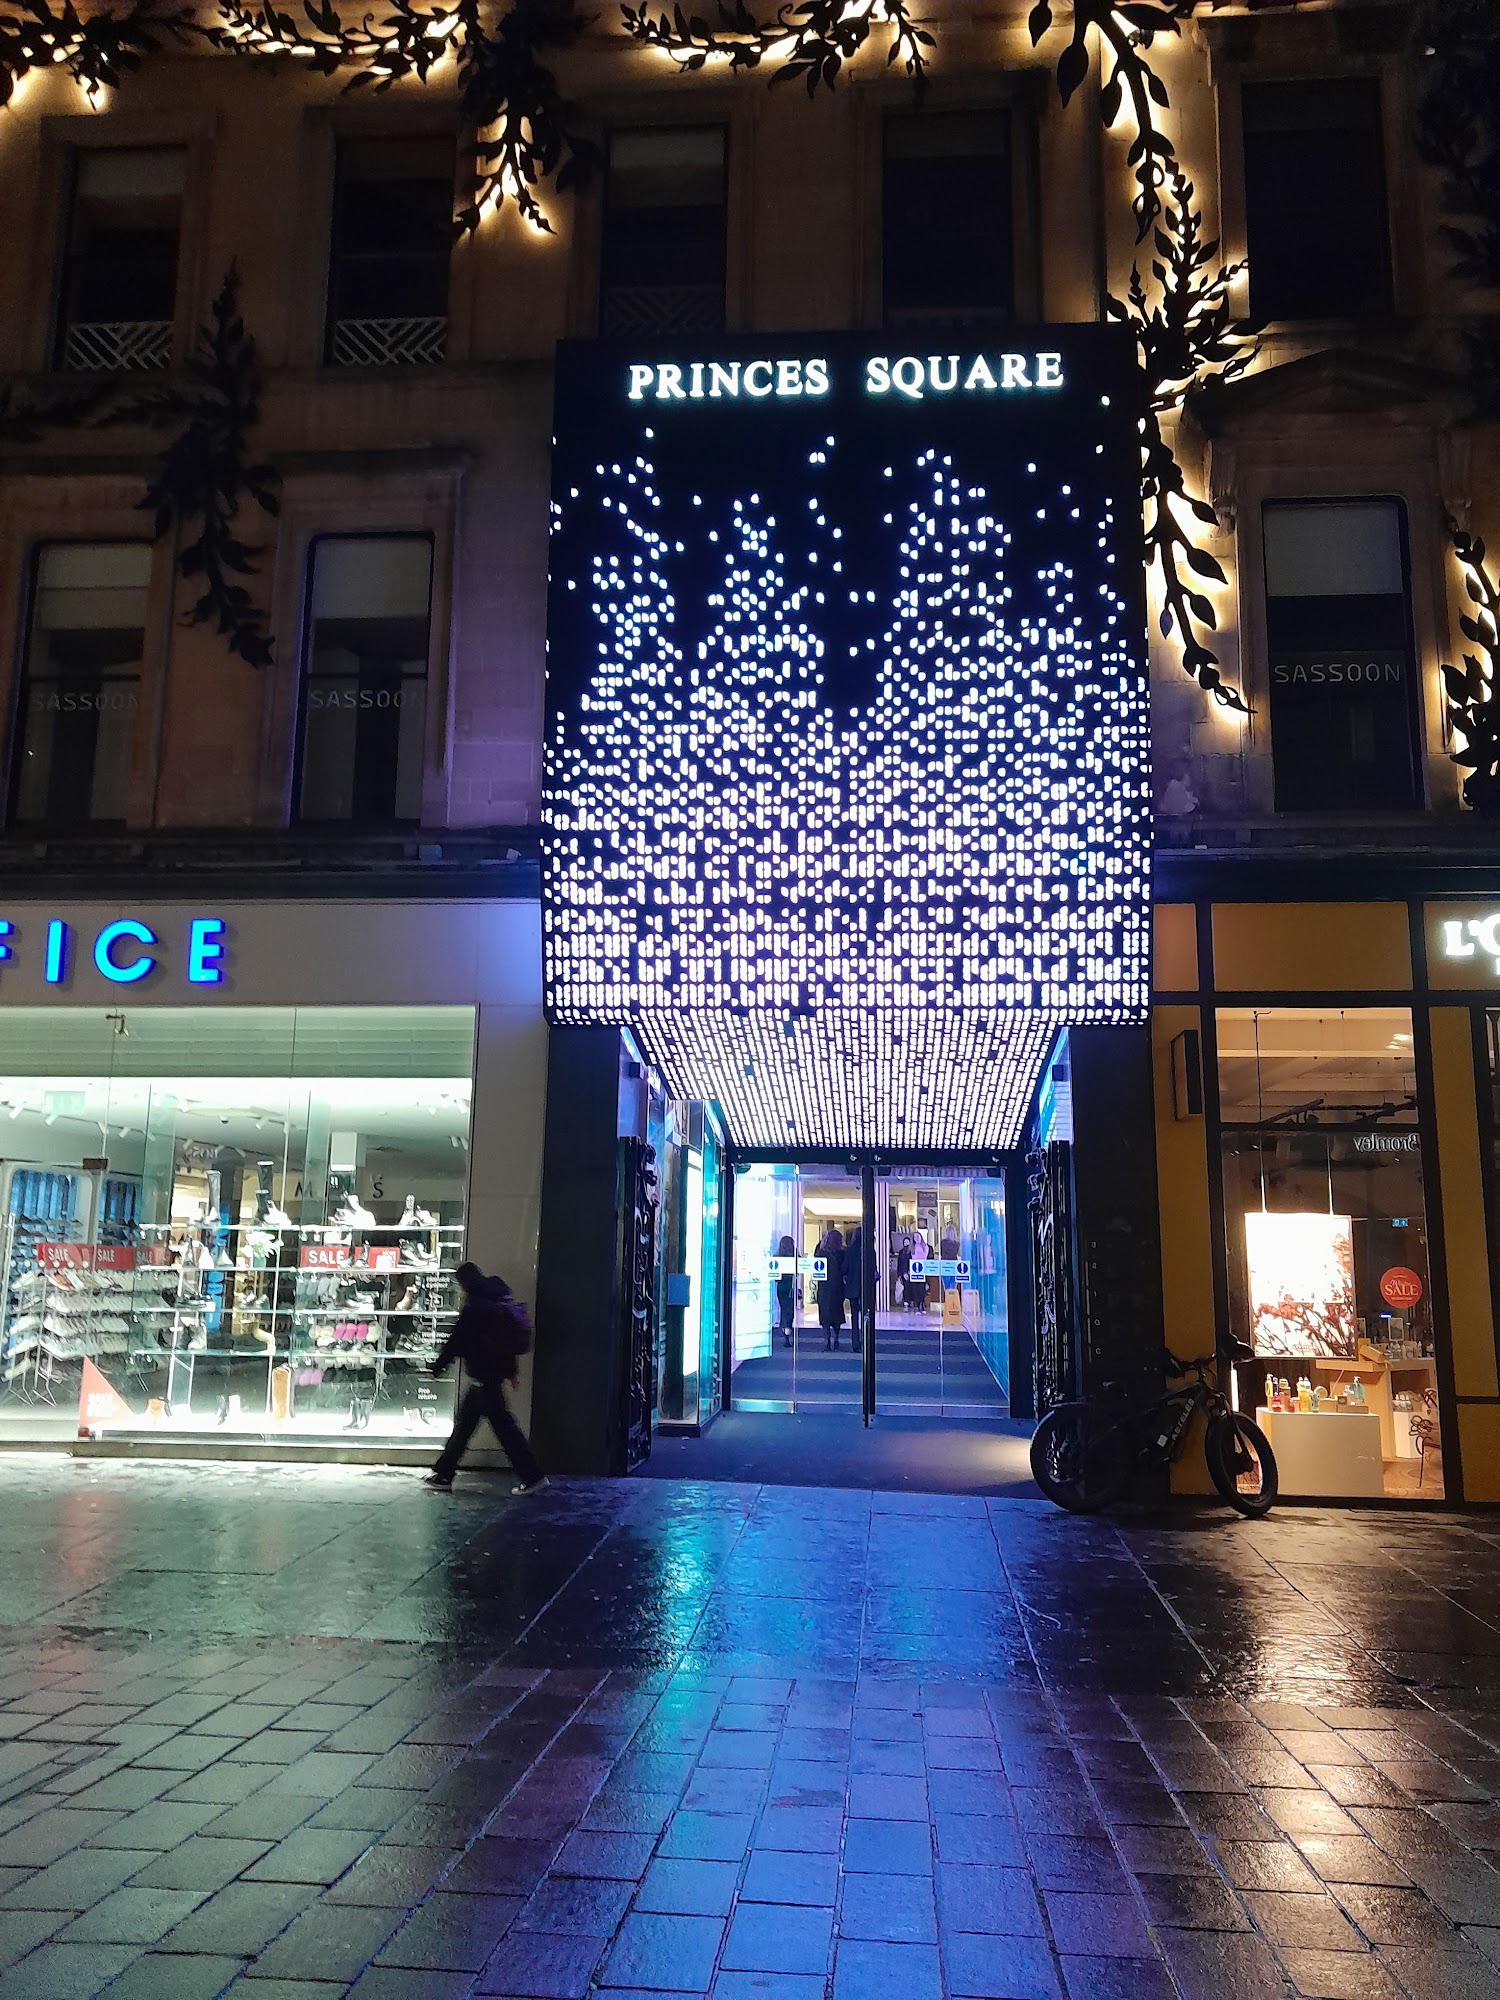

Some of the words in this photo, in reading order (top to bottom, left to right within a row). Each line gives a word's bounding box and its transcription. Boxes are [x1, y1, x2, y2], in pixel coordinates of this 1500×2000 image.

[627, 358, 829, 400] PRINCES
[866, 352, 1065, 399] SQUARE
[1274, 663, 1400, 683] SASSOON
[309, 689, 417, 709] SASSOO
[47, 1247, 69, 1263] SALE
[97, 1248, 116, 1263] SALE
[308, 1249, 345, 1265] SALE
[1384, 1284, 1419, 1297] SALE
